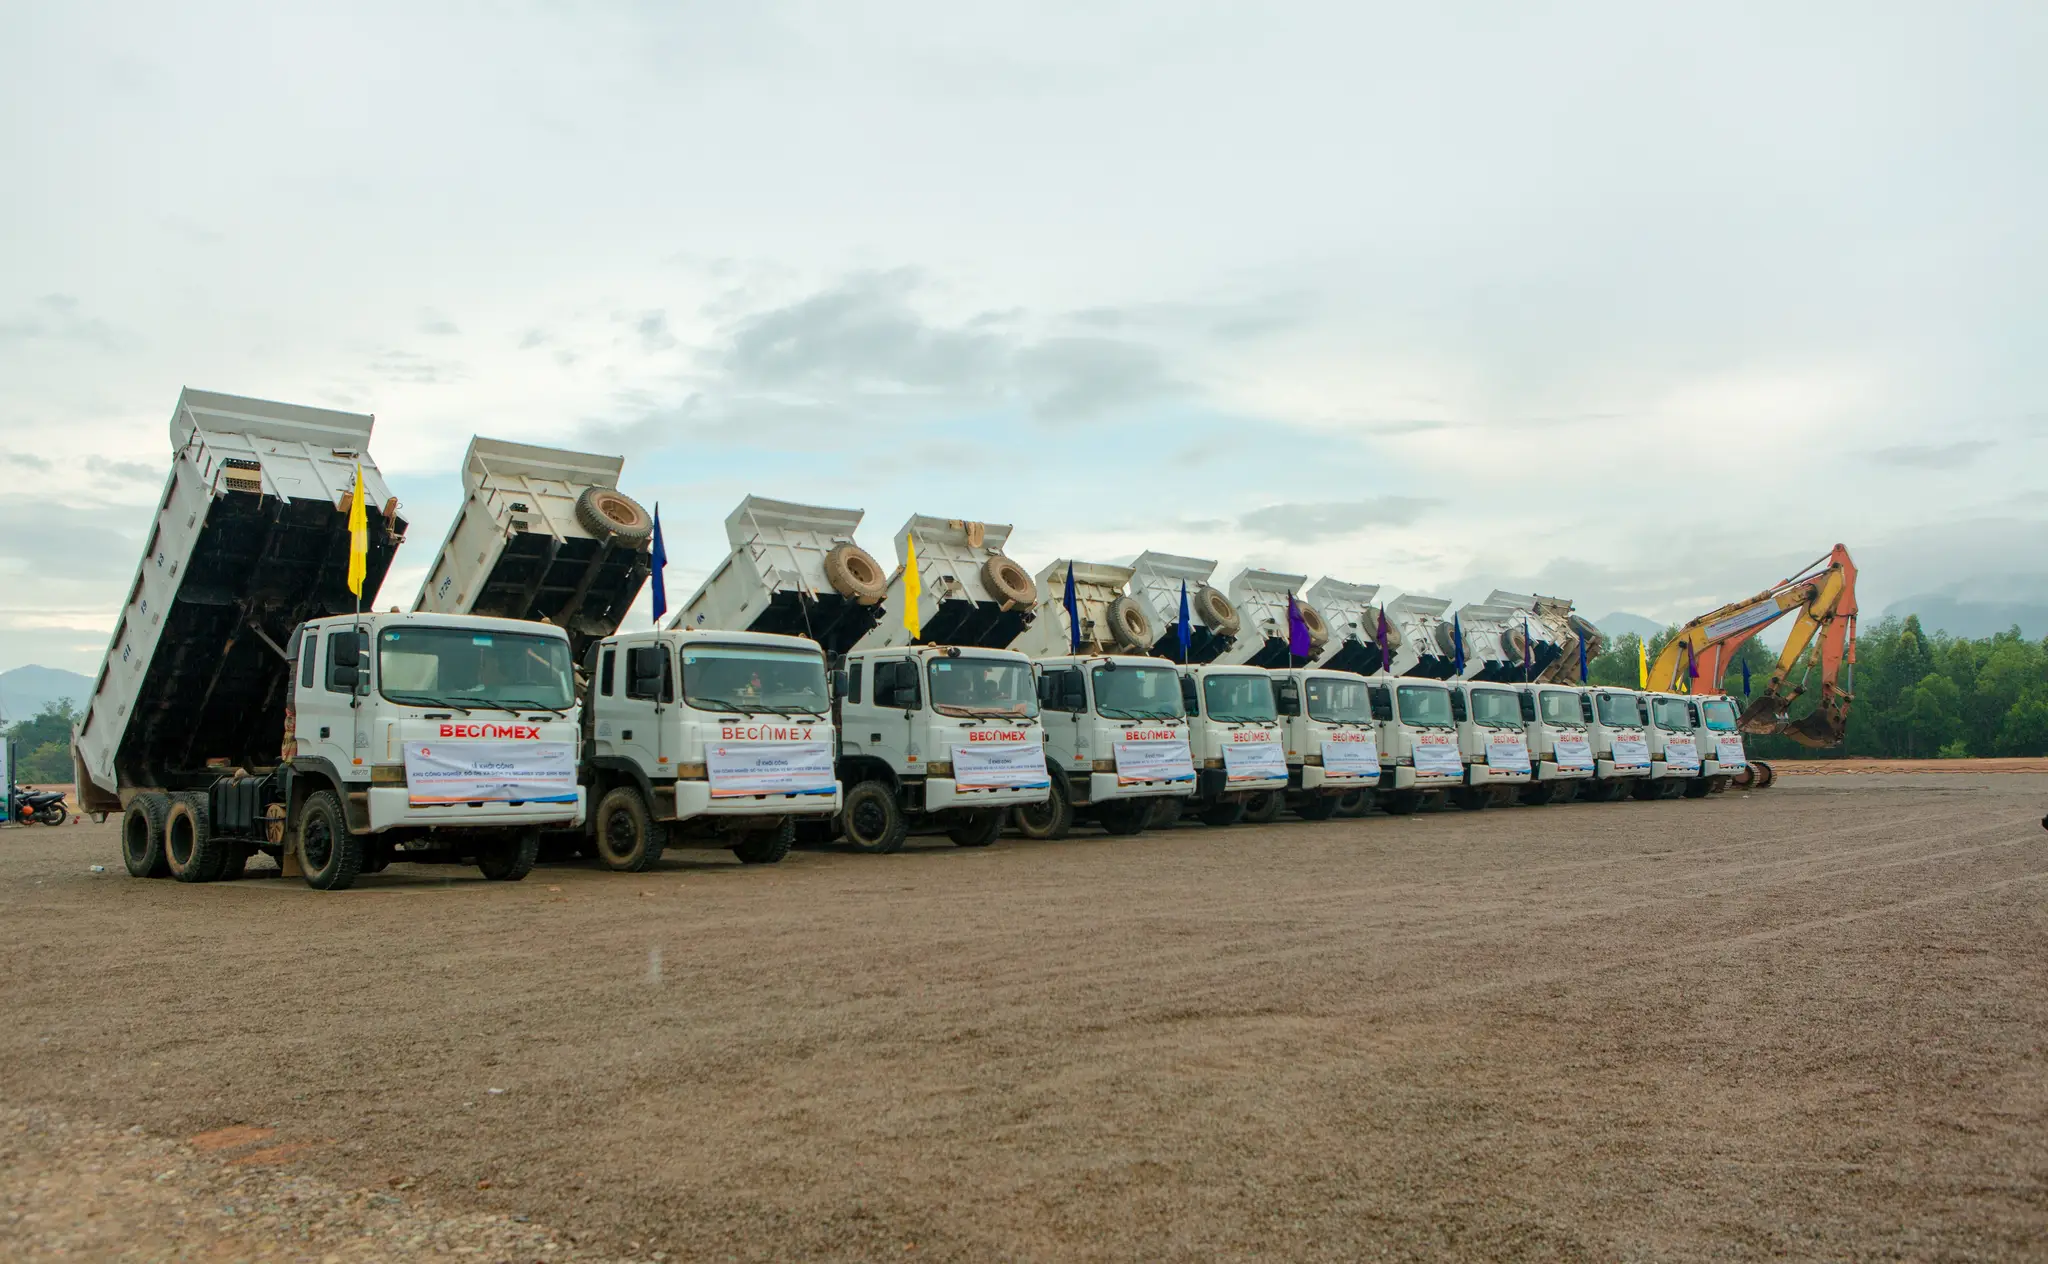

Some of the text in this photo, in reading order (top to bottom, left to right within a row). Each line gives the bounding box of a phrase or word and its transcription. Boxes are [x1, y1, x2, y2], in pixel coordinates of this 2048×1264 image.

[440, 724, 540, 739] BECAMEX
[722, 724, 812, 740] BECAMEX
[969, 730, 1026, 741] BECAMEX
[1126, 730, 1176, 740] BECAMEX
[1233, 730, 1271, 742] BECAMEX
